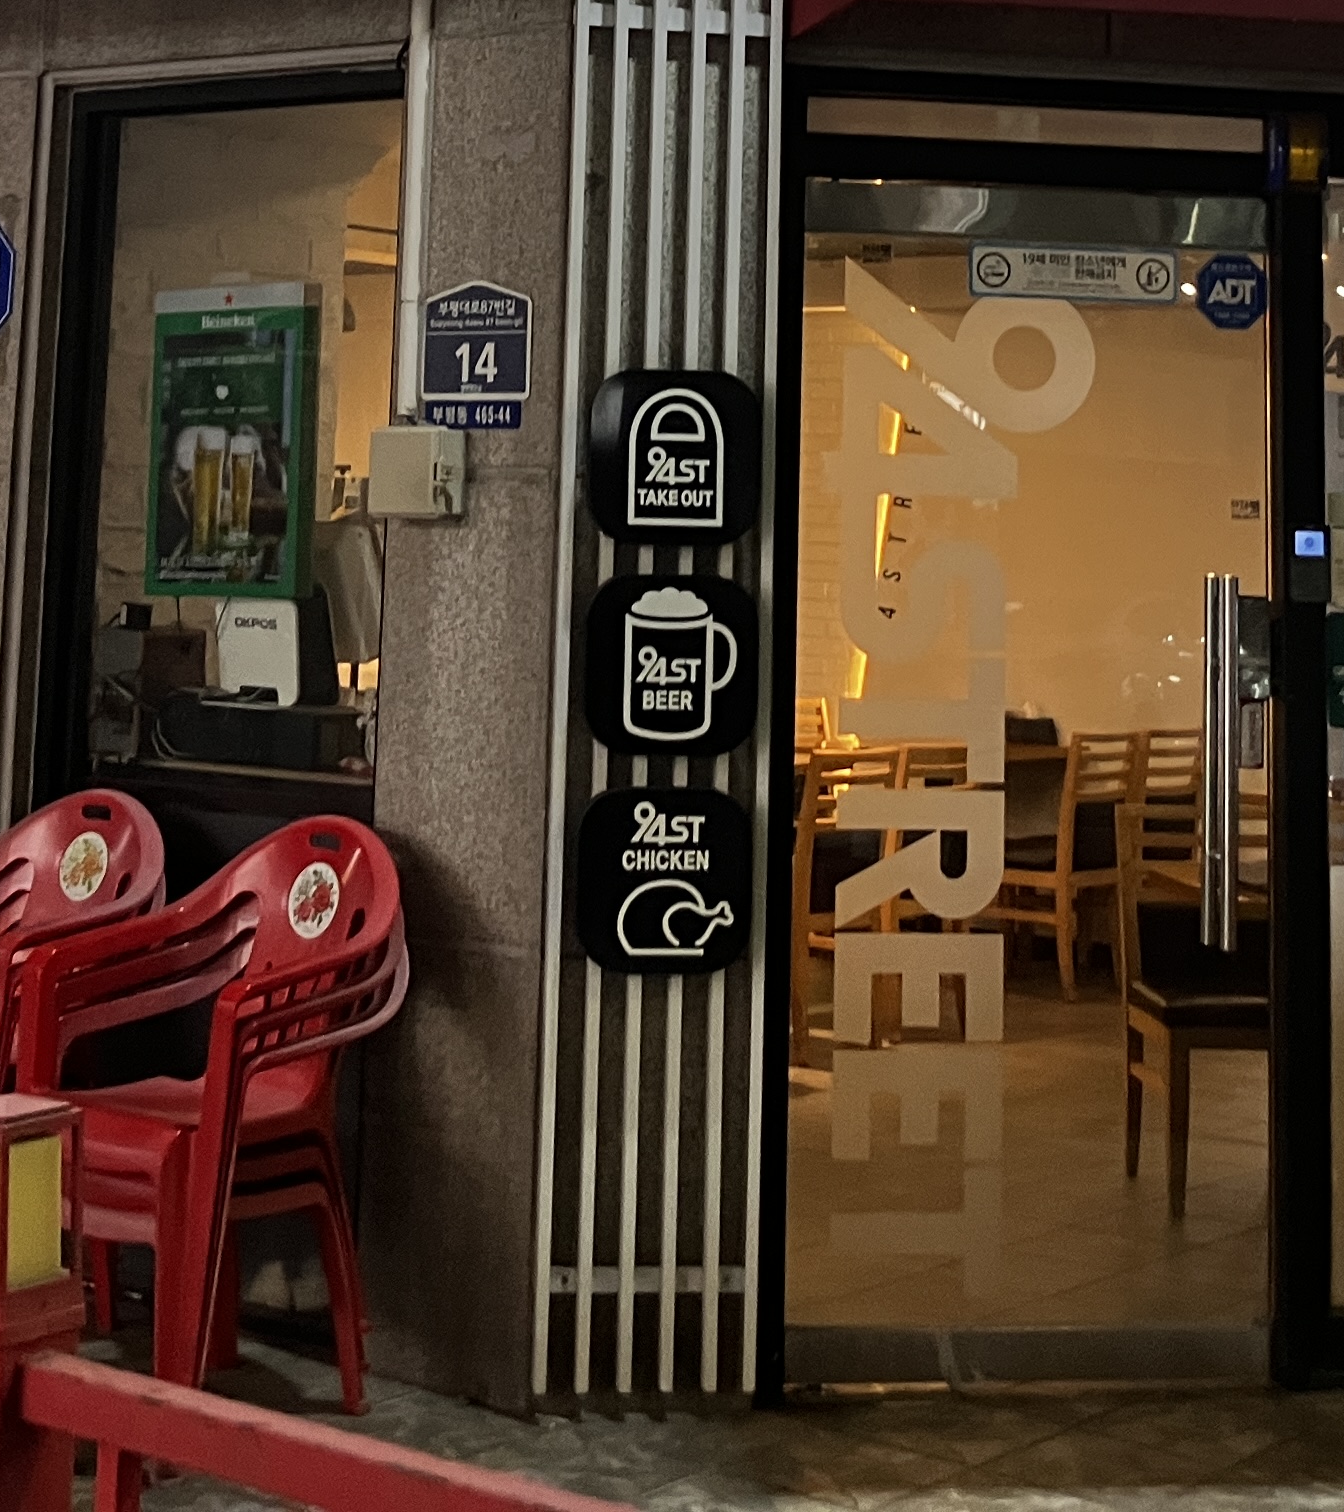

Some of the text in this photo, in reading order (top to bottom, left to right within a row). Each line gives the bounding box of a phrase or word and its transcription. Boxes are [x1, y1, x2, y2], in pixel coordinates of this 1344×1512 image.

[1206, 278, 1257, 306] ADT
[455, 341, 498, 384] 14
[637, 489, 714, 508] TAKE OUT
[642, 690, 693, 711] BEER
[621, 849, 710, 872] CHICKEN
